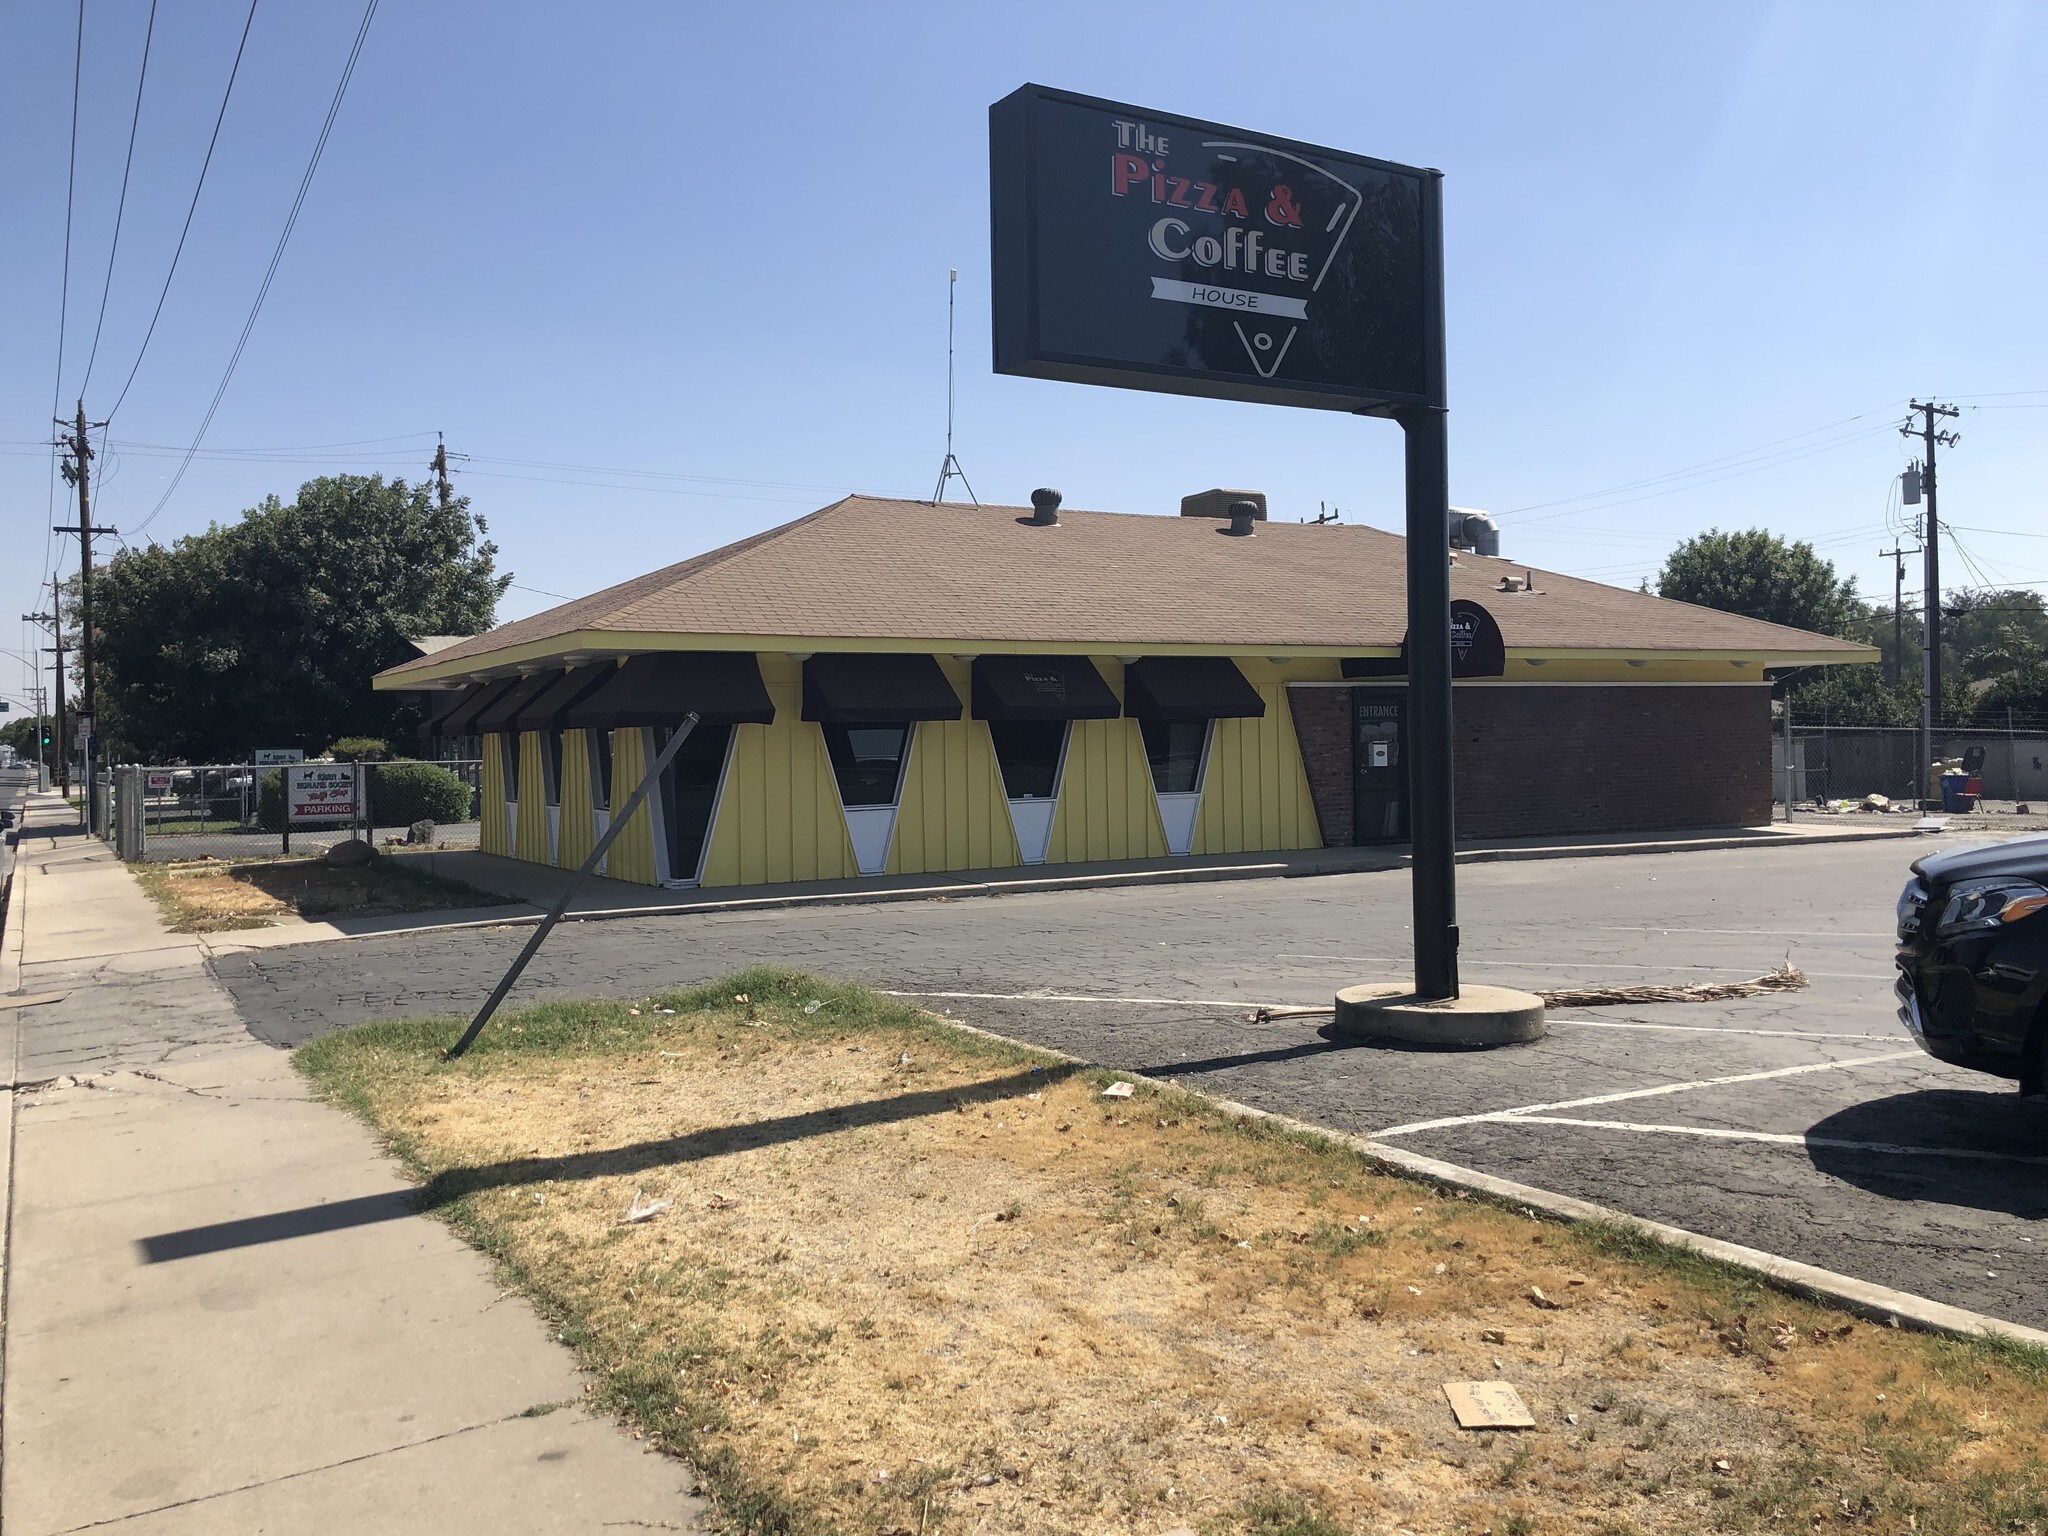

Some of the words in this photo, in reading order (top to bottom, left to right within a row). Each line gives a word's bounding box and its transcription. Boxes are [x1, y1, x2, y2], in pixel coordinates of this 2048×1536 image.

[1111, 153, 1248, 219] Pizza
[1264, 184, 1303, 229] &
[1148, 217, 1309, 282] Coffee
[1192, 287, 1259, 309] HOUSE
[1359, 704, 1399, 718] ENTRANCE
[304, 805, 351, 813] PARKING
